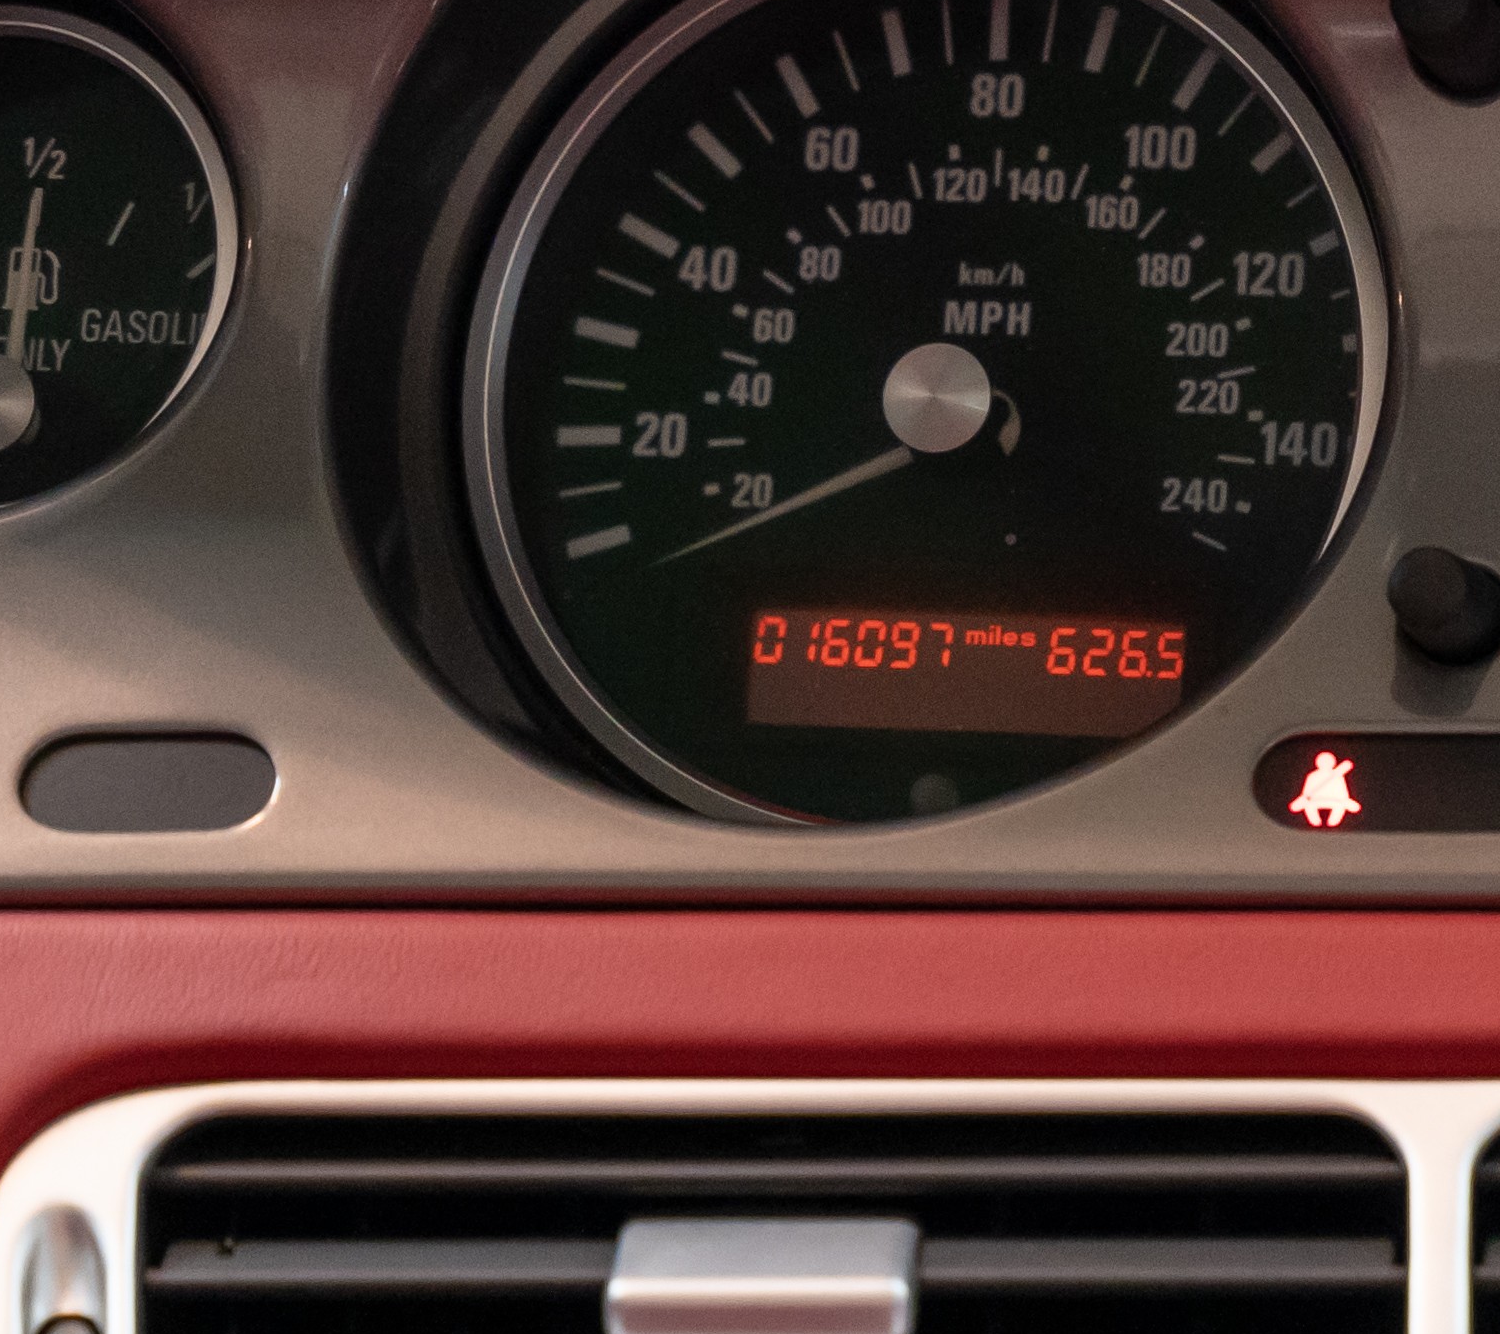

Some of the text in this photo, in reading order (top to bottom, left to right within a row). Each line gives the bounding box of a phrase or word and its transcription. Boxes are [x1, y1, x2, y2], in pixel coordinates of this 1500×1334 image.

[969, 73, 1025, 118] 80
[23, 137, 67, 180] 1/2
[804, 126, 859, 171] 60
[1124, 125, 1197, 170] 100
[933, 168, 987, 203] 120
[1008, 168, 1066, 203] 140
[858, 200, 912, 235] 100
[1086, 195, 1139, 230] 160
[678, 246, 738, 292] 40
[799, 246, 841, 281] 80
[958, 261, 1025, 286] km/h
[1137, 253, 1191, 287] 180
[1233, 251, 1304, 297] 120
[80, 308, 208, 345] GASOLI
[753, 308, 795, 343] 60
[944, 301, 1031, 336] MPH
[1165, 323, 1229, 357] 200
[727, 372, 772, 407] 40
[1176, 380, 1240, 415] 220
[632, 413, 688, 457] 20
[1260, 422, 1337, 467] 140
[731, 474, 772, 508] 20
[1160, 478, 1227, 513] 240
[753, 615, 1185, 679] 016097 miles 626.5
